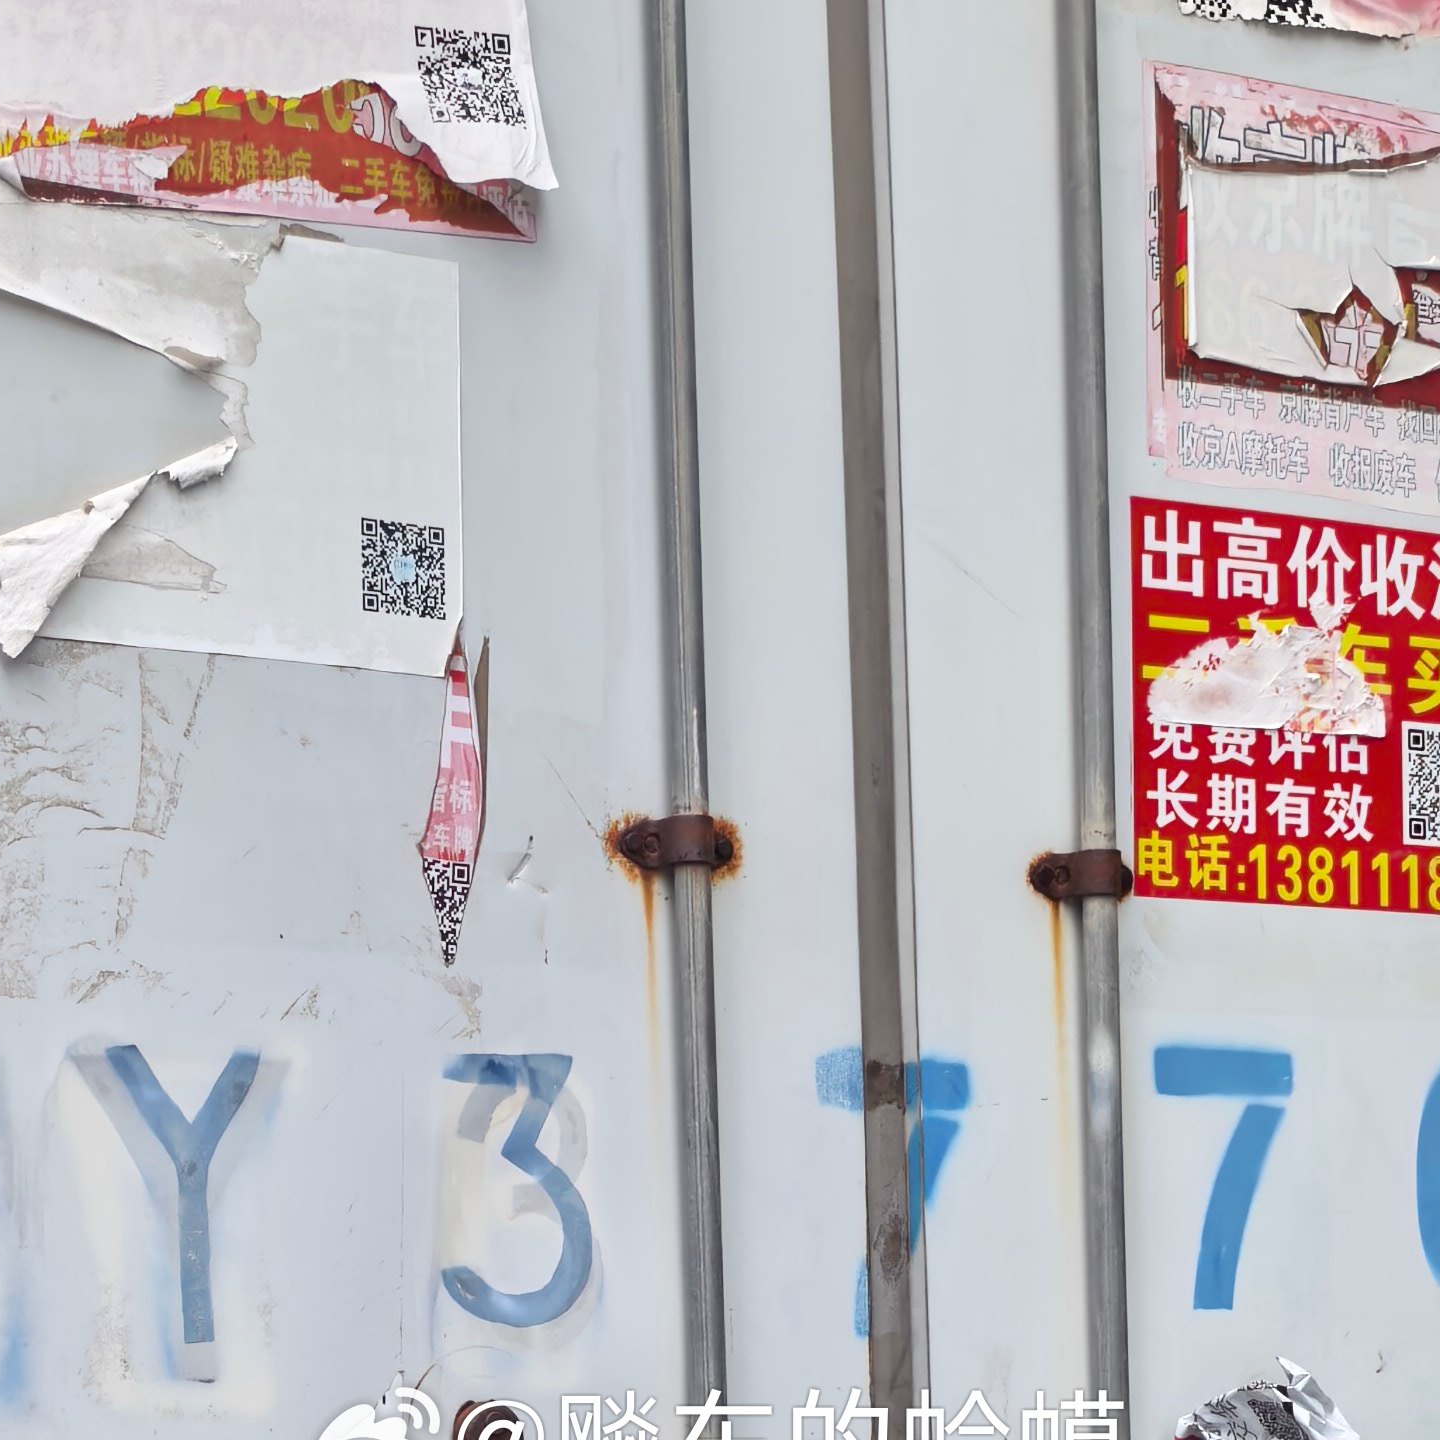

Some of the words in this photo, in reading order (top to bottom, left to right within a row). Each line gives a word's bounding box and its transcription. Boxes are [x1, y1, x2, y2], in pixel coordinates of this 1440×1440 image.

[1149, 721, 1370, 776] 免费评估
[1145, 767, 1375, 844] 长期有效
